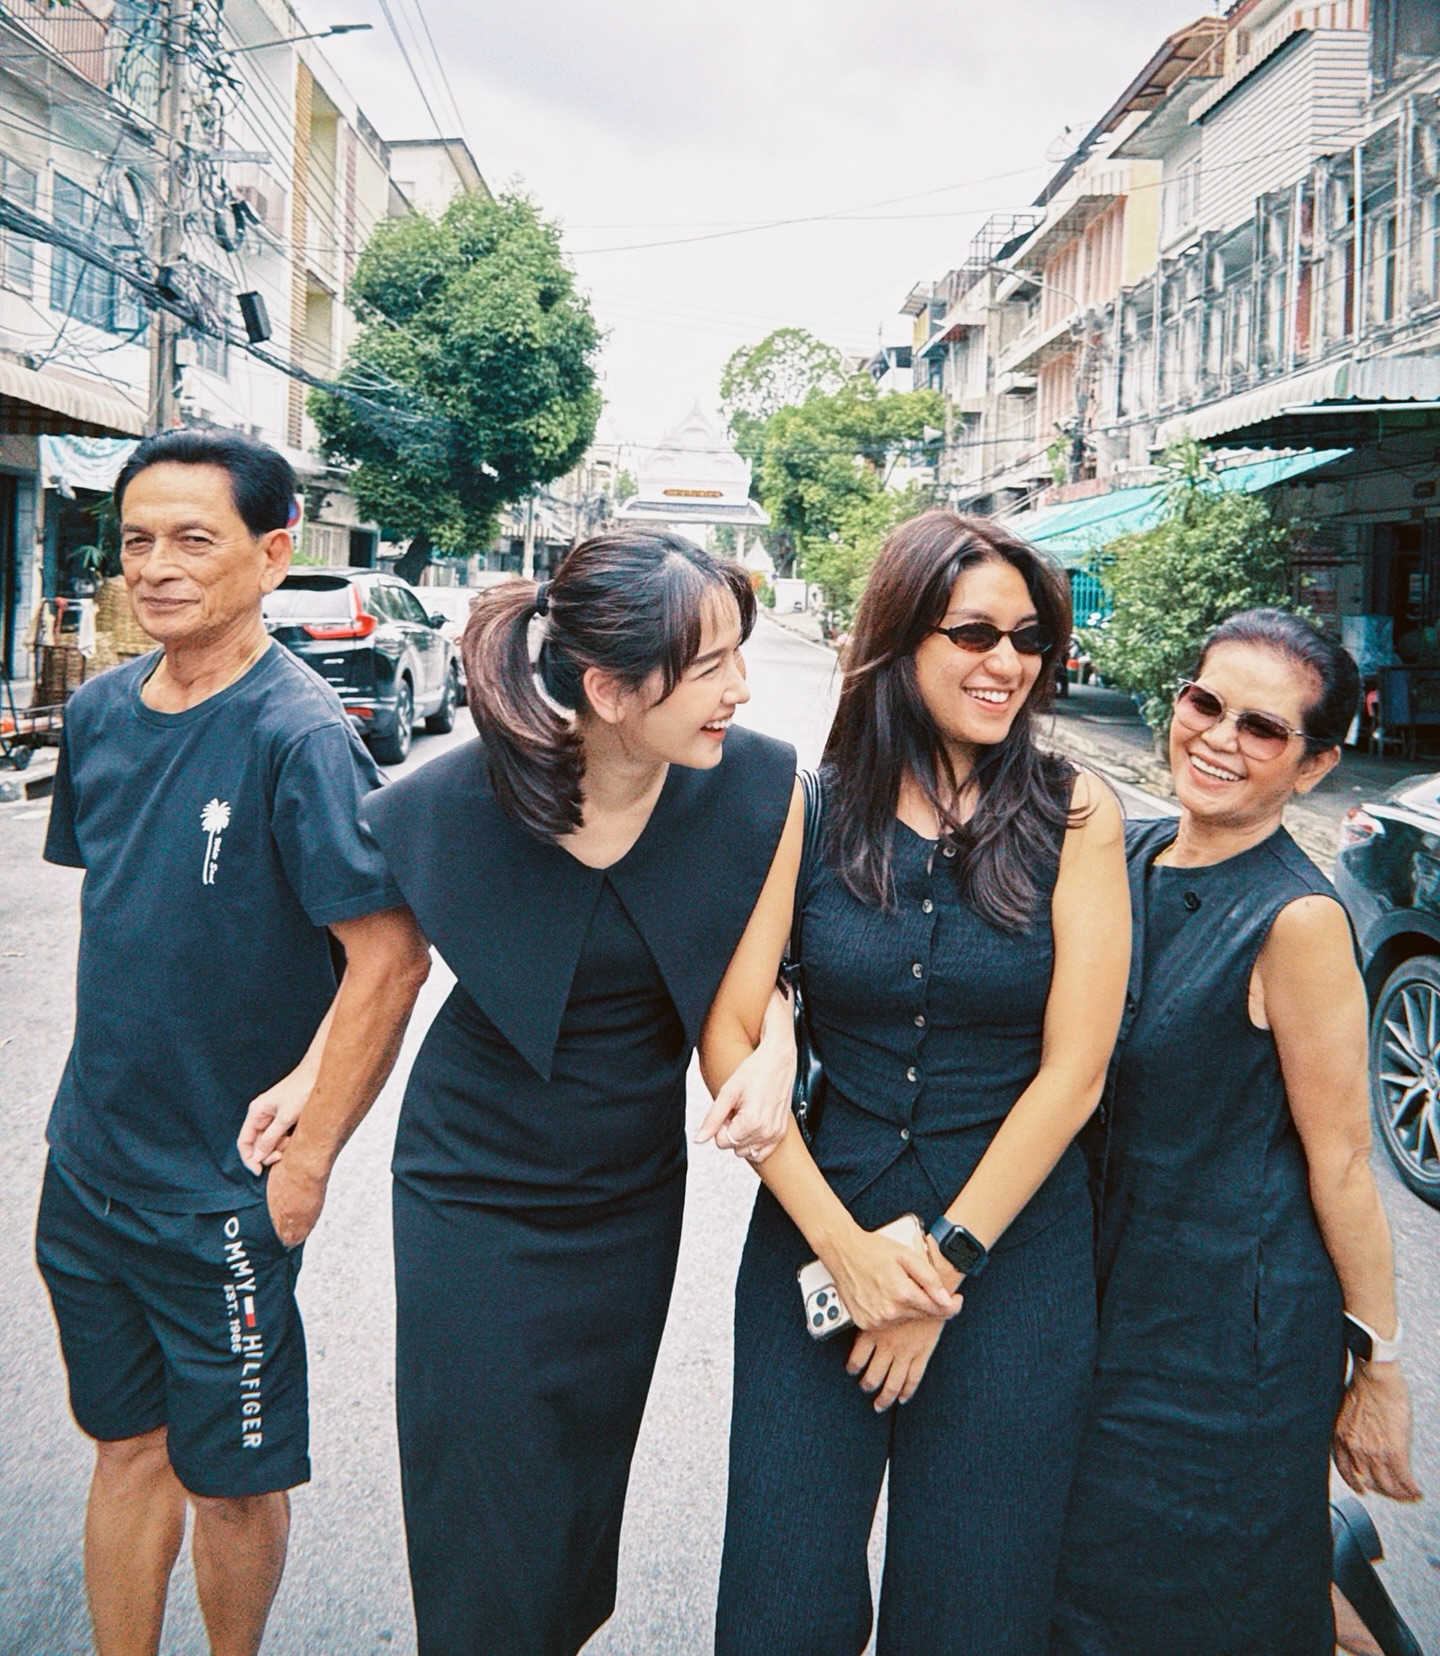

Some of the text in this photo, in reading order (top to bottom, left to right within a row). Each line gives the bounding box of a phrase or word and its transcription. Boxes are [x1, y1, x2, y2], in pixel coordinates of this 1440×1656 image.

[223, 1284, 239, 1317] EST.
[224, 1216, 264, 1449] OMMY HILFIGER
